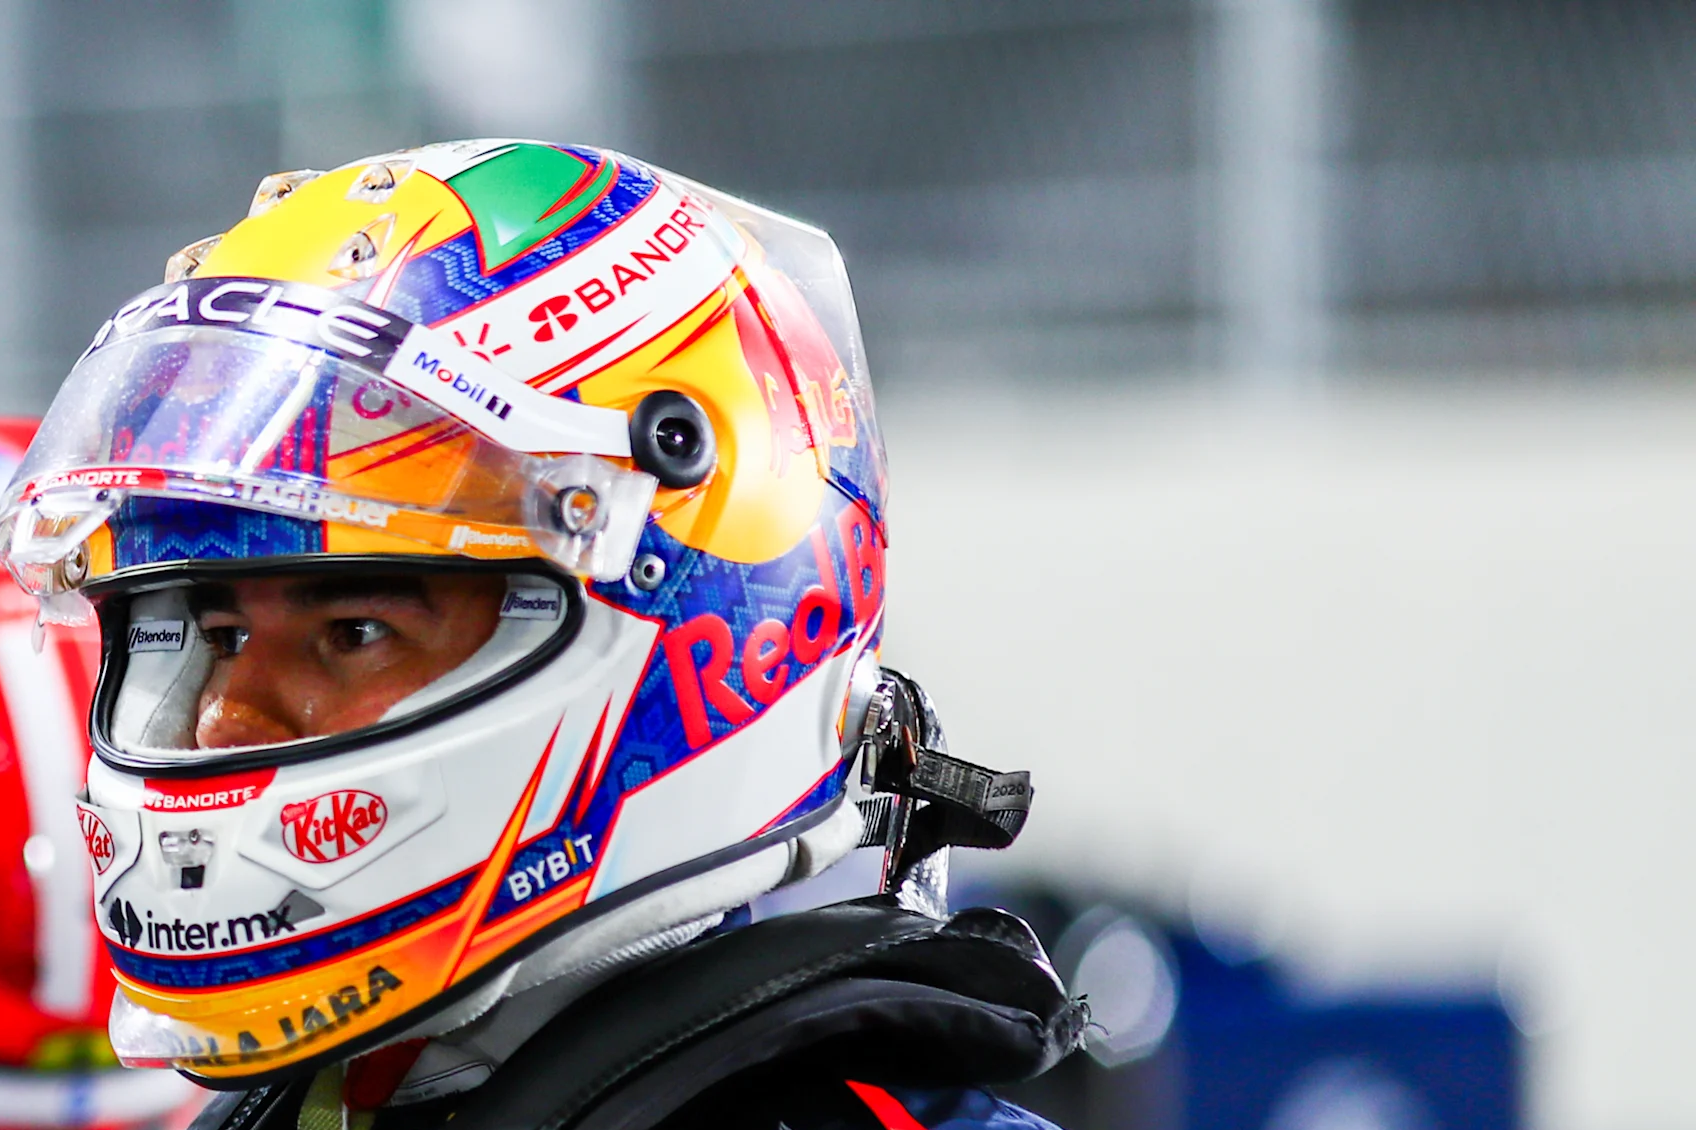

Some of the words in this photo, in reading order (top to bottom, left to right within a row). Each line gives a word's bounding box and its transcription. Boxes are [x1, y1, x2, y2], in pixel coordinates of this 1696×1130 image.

[574, 193, 714, 314] BANORT
[412, 351, 488, 405] Mobil
[662, 524, 842, 750] Red
[163, 786, 256, 809] BANORTE
[292, 792, 382, 863] KitKat
[507, 833, 593, 902] BYBIT
[148, 904, 296, 952] inter.mx
